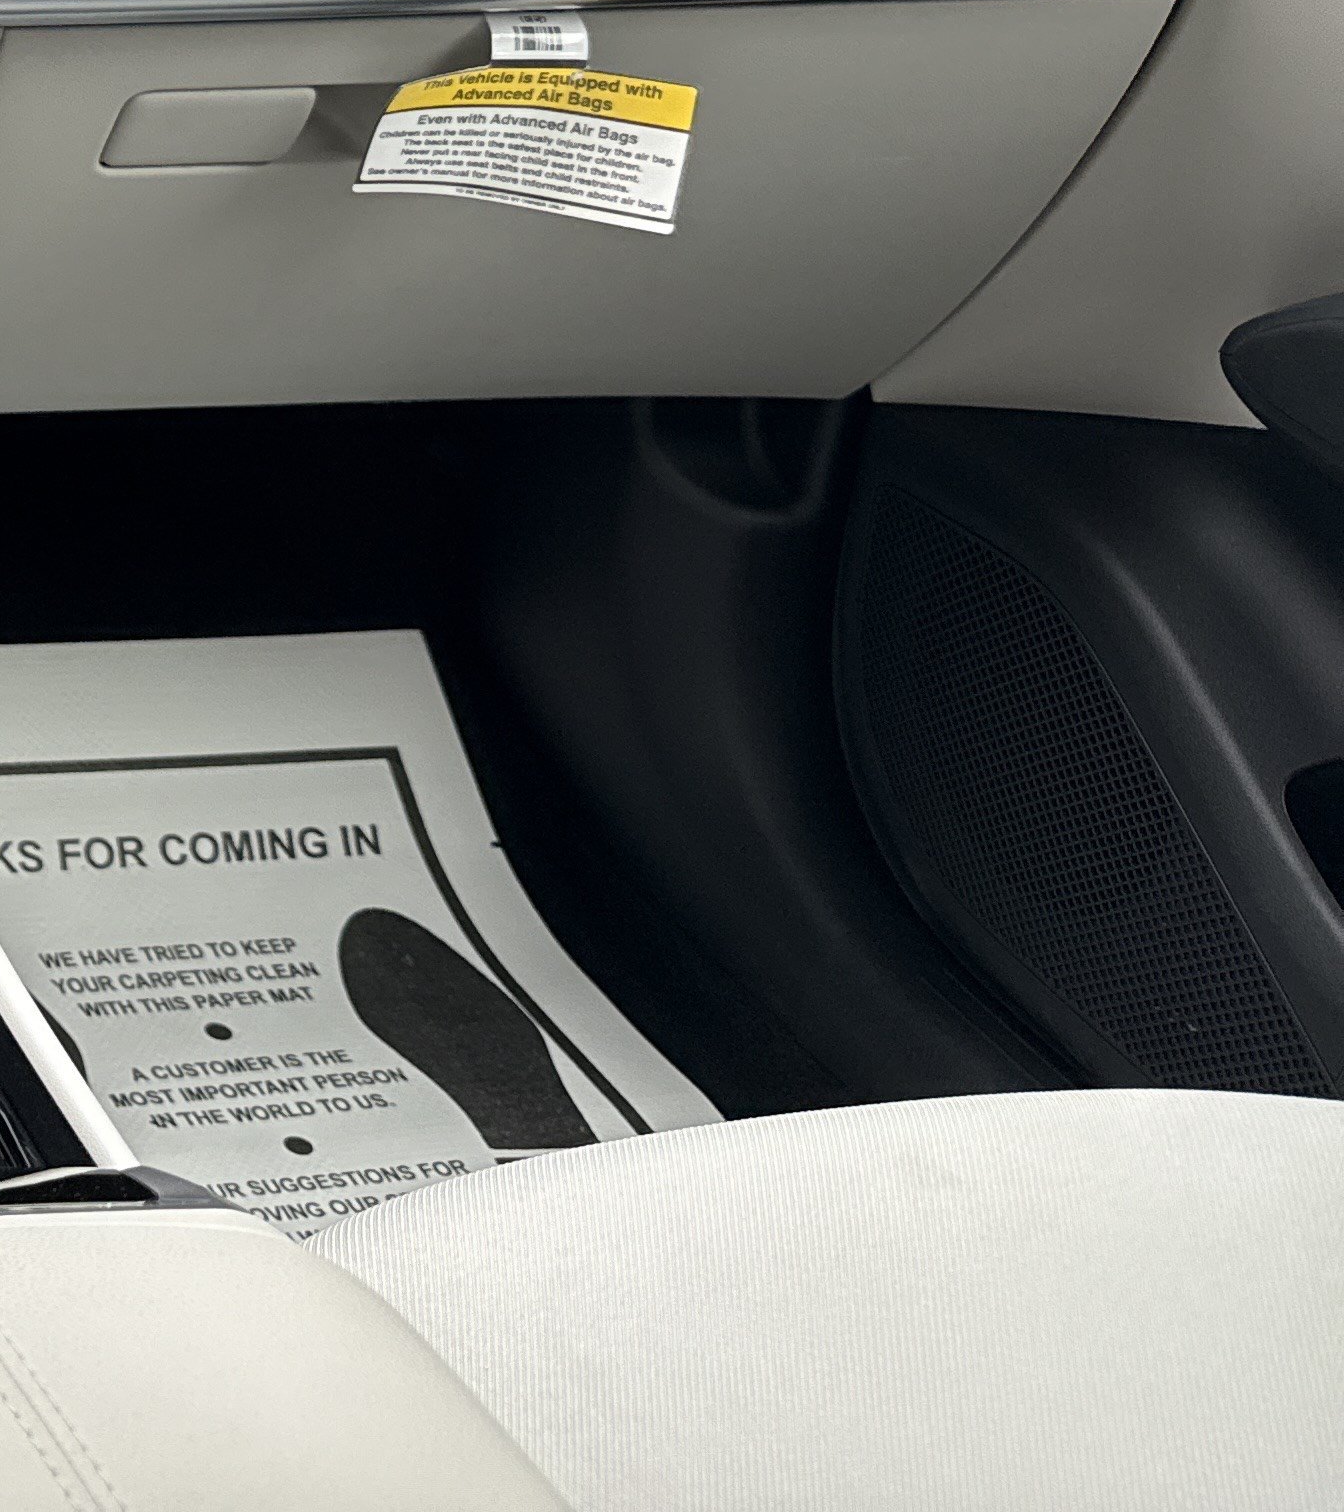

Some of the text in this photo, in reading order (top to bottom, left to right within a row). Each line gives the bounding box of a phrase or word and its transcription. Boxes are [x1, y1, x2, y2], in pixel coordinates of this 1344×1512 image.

[424, 78, 454, 90] This
[518, 71, 533, 85] is
[537, 72, 621, 94] Equipped
[625, 80, 663, 100] with
[451, 88, 613, 112] Advanced Air Bags
[417, 113, 638, 146] Even with Advanced Air Bags
[57, 836, 149, 871] FOR
[159, 826, 328, 867] COMING
[340, 823, 382, 858] IN
[38, 937, 297, 969] WE HAVE TRIED TO KEEP
[50, 961, 321, 996] YOUR CARPETING CLEAN
[77, 985, 314, 1018] WITH THIS PAPER MAT
[131, 1048, 353, 1082] A CUSTOMER IS THE
[108, 1066, 409, 1108] MOST IMPORTANT PERSON
[150, 1092, 397, 1129] IN THE WORLD TO US.
[246, 1164, 416, 1196] SUGGESTIONS
[416, 1159, 473, 1180] FOR
